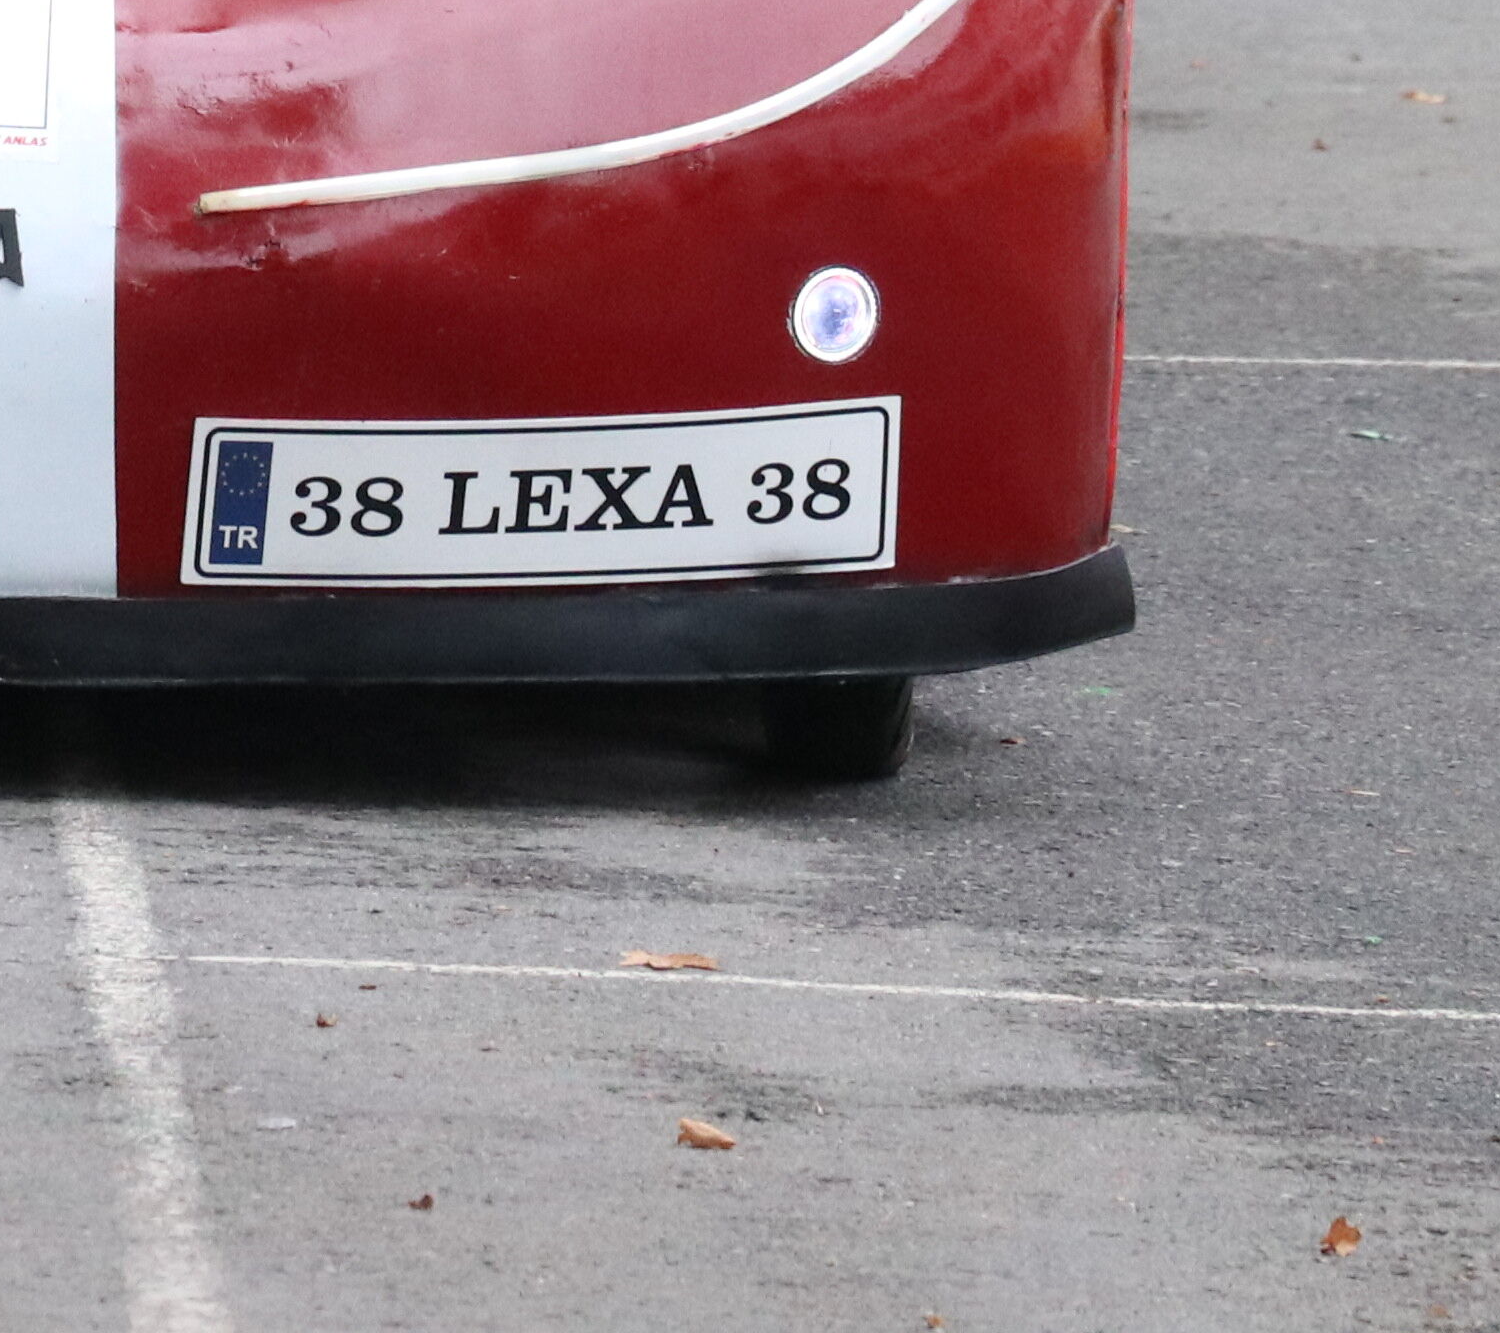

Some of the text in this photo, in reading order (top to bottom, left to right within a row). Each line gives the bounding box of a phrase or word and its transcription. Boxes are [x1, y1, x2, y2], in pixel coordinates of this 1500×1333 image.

[289, 458, 853, 537] 38 LEXA 38
[218, 525, 260, 550] TR
